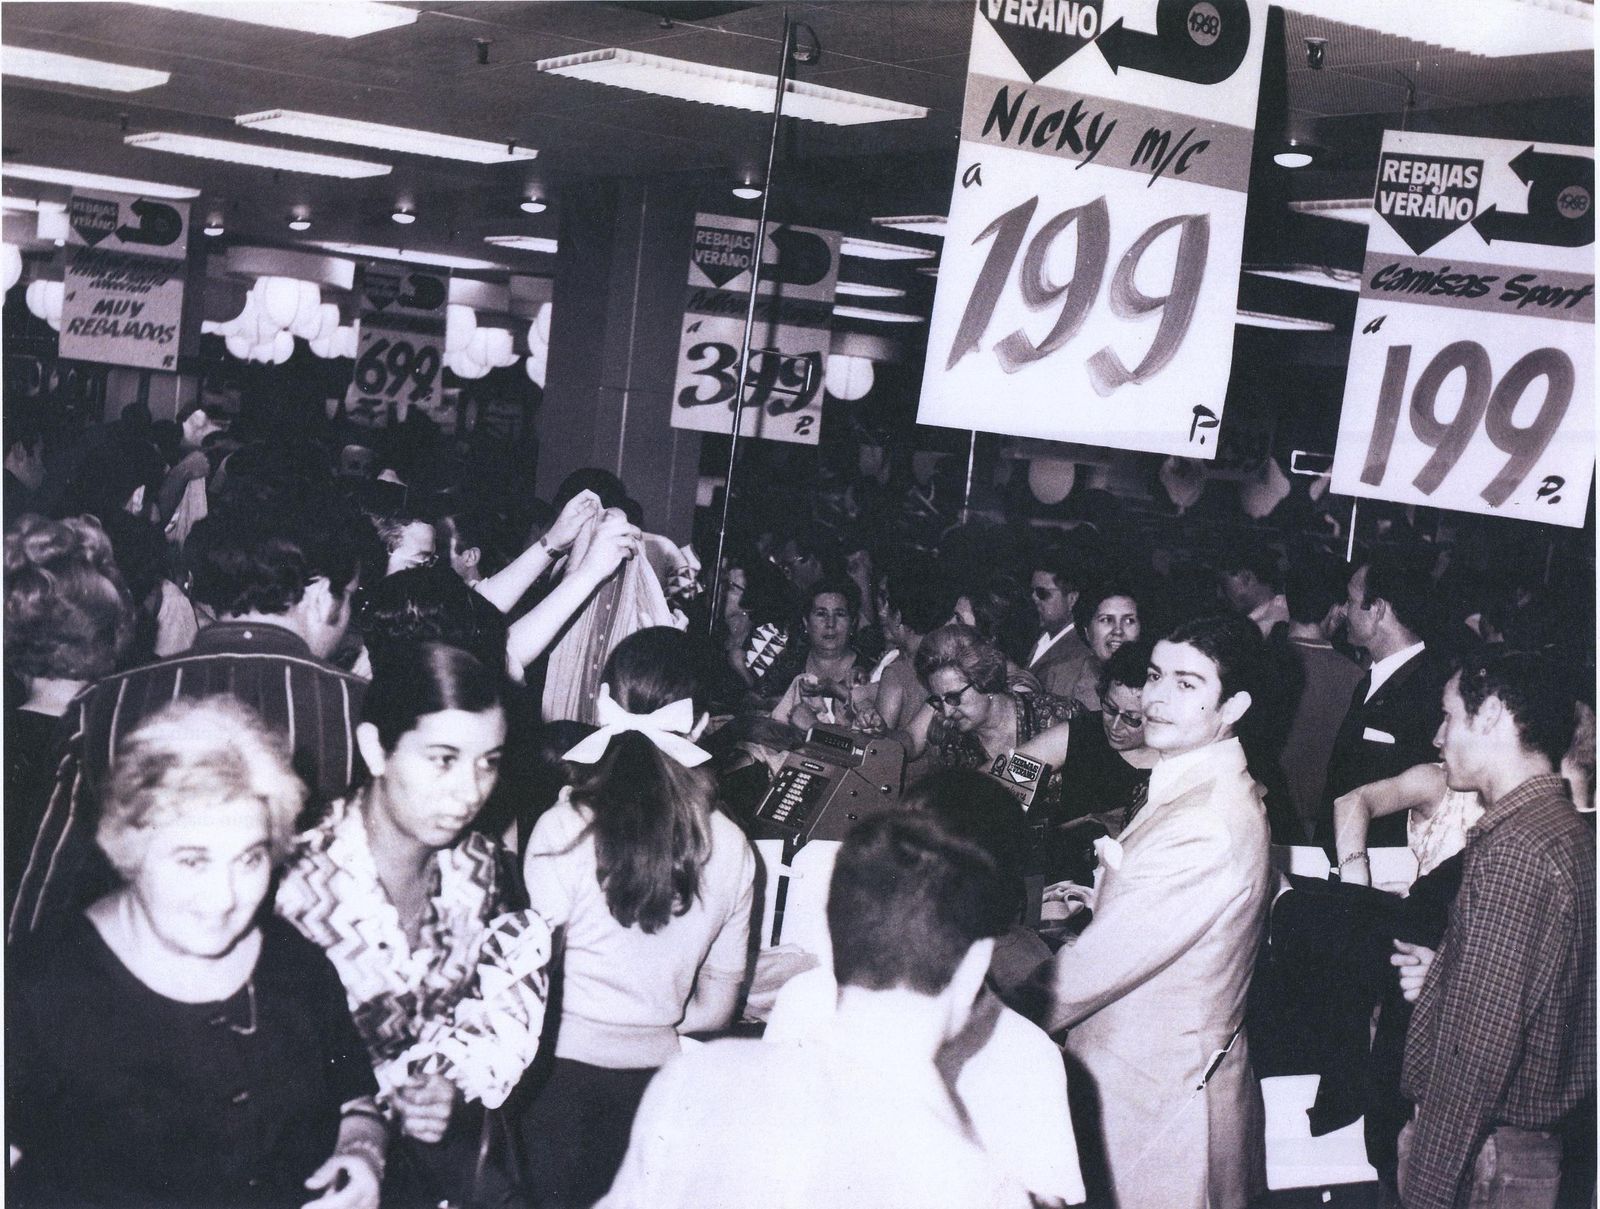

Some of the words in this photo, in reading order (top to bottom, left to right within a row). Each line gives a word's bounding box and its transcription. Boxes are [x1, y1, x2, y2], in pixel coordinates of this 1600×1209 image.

[987, 0, 1098, 39] VERANO
[1189, 11, 1219, 36] 1968
[982, 85, 1118, 170] Nicky
[962, 163, 983, 189] a
[1382, 159, 1479, 194] REBAJAS
[1380, 190, 1474, 221] VERANO
[1560, 193, 1589, 211] 1968
[696, 230, 752, 251] REBAJAS
[695, 248, 749, 268] VERANO
[945, 194, 1211, 398] 199
[1370, 263, 1499, 298] Camisas
[1500, 273, 1594, 310] Sport
[92, 299, 145, 319] MUY
[66, 317, 176, 344] REBAJADOS
[678, 342, 823, 417] 399
[1360, 340, 1576, 508] 199
